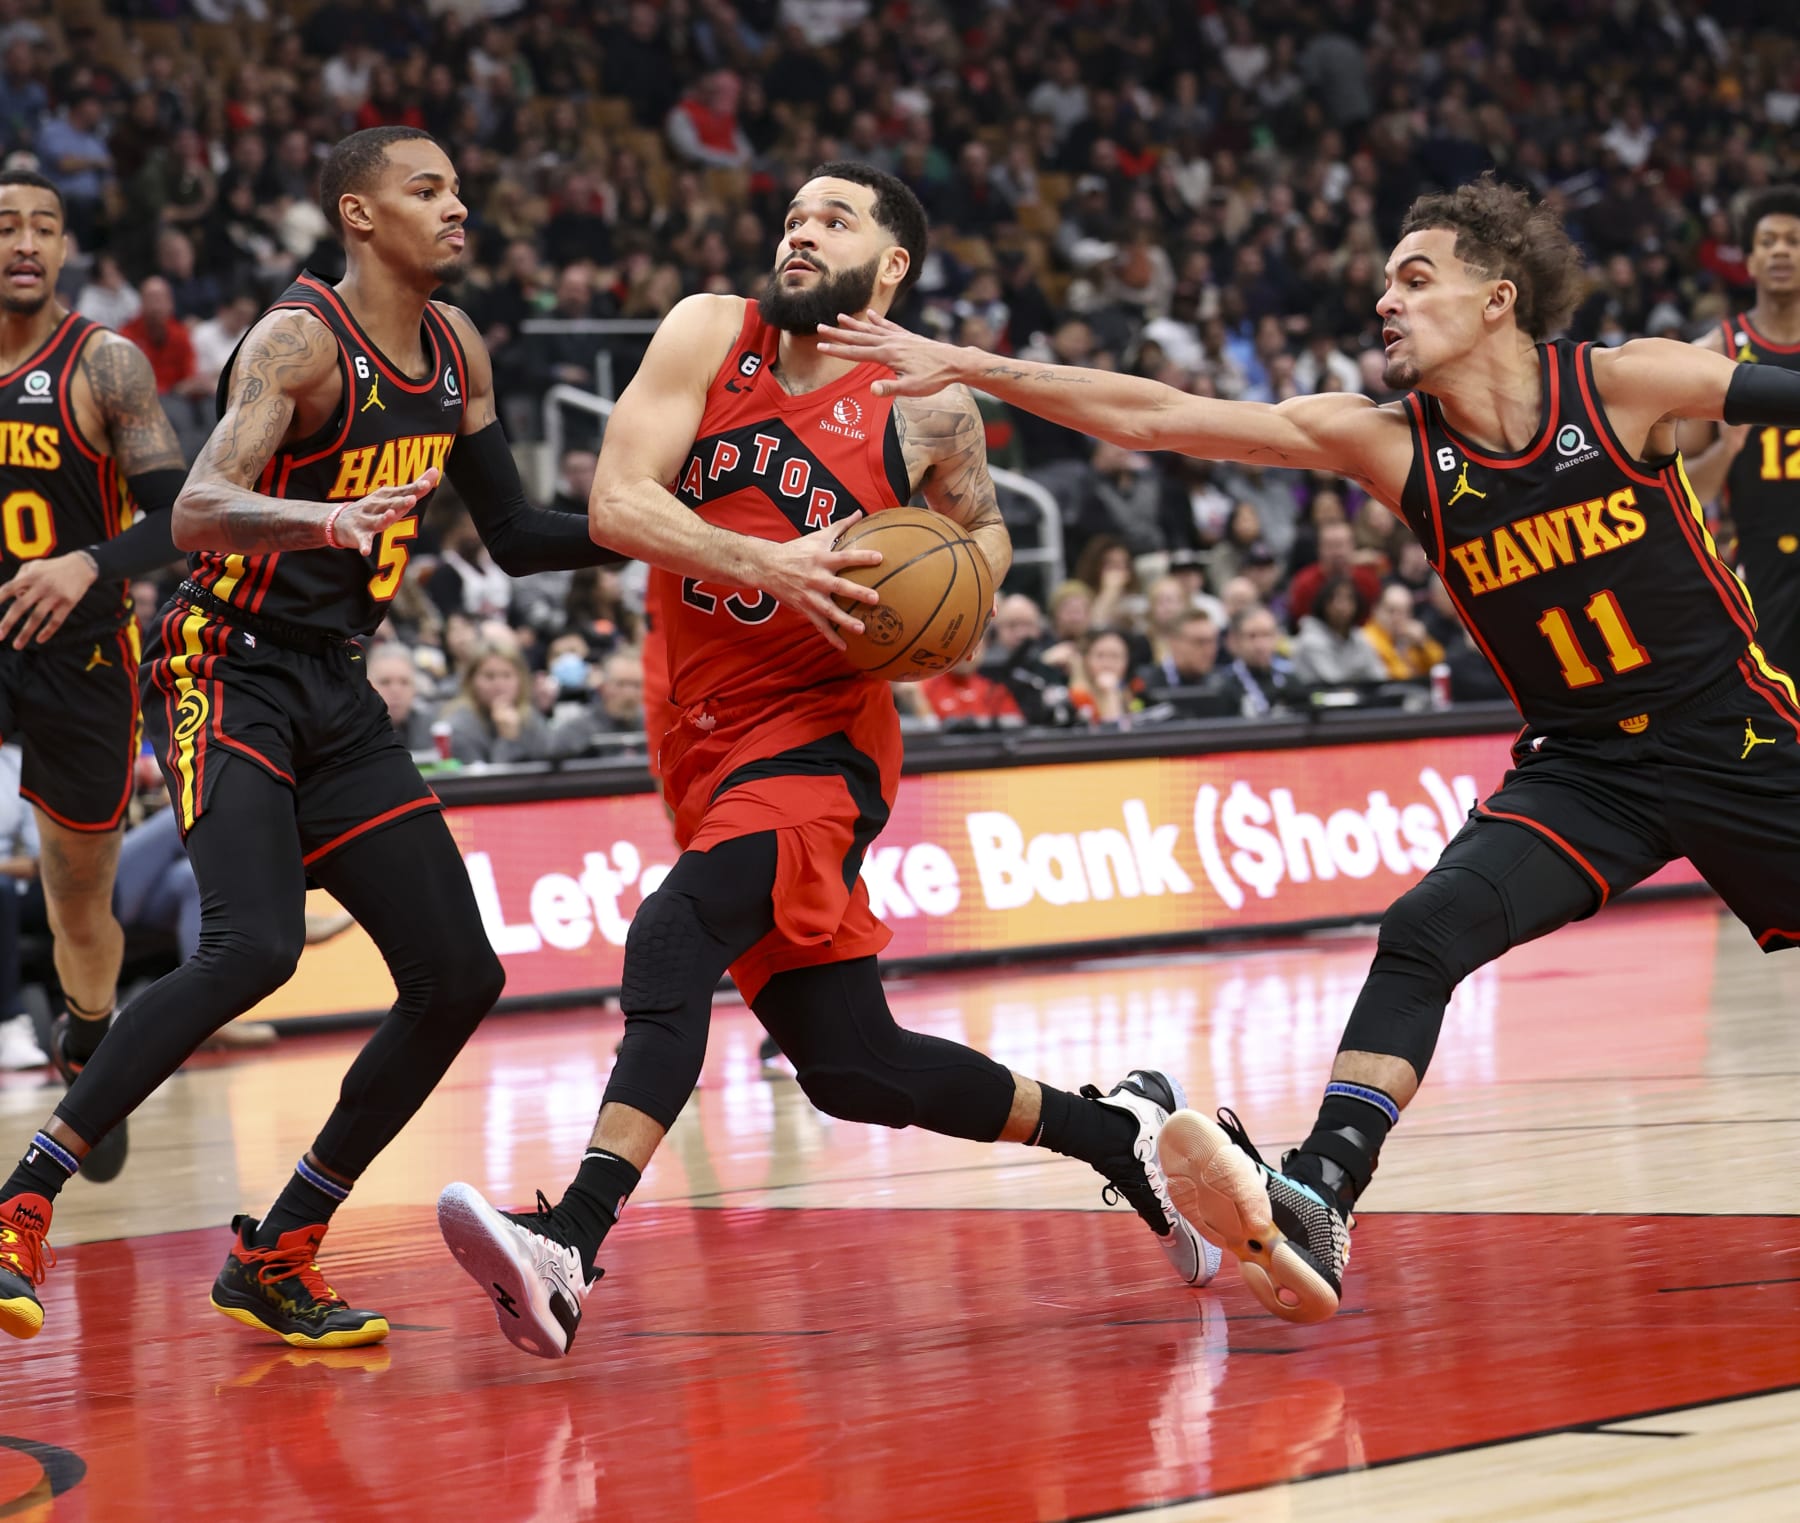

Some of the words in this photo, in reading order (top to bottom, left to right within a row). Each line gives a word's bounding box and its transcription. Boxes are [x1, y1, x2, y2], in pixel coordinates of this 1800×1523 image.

[354, 356, 370, 379] 6
[741, 355, 761, 376] 6
[819, 419, 842, 434] Sun
[843, 427, 866, 440] Life
[1436, 446, 1457, 472] 6
[1554, 449, 1600, 473] sharecare
[326, 433, 456, 500] HAWK
[674, 433, 838, 531] APTOR
[0, 489, 58, 561] 0
[367, 515, 418, 602] 5
[1450, 486, 1648, 597] HAWKS
[1536, 588, 1651, 690] 11
[859, 842, 961, 920] ke
[965, 797, 1195, 911] Bank
